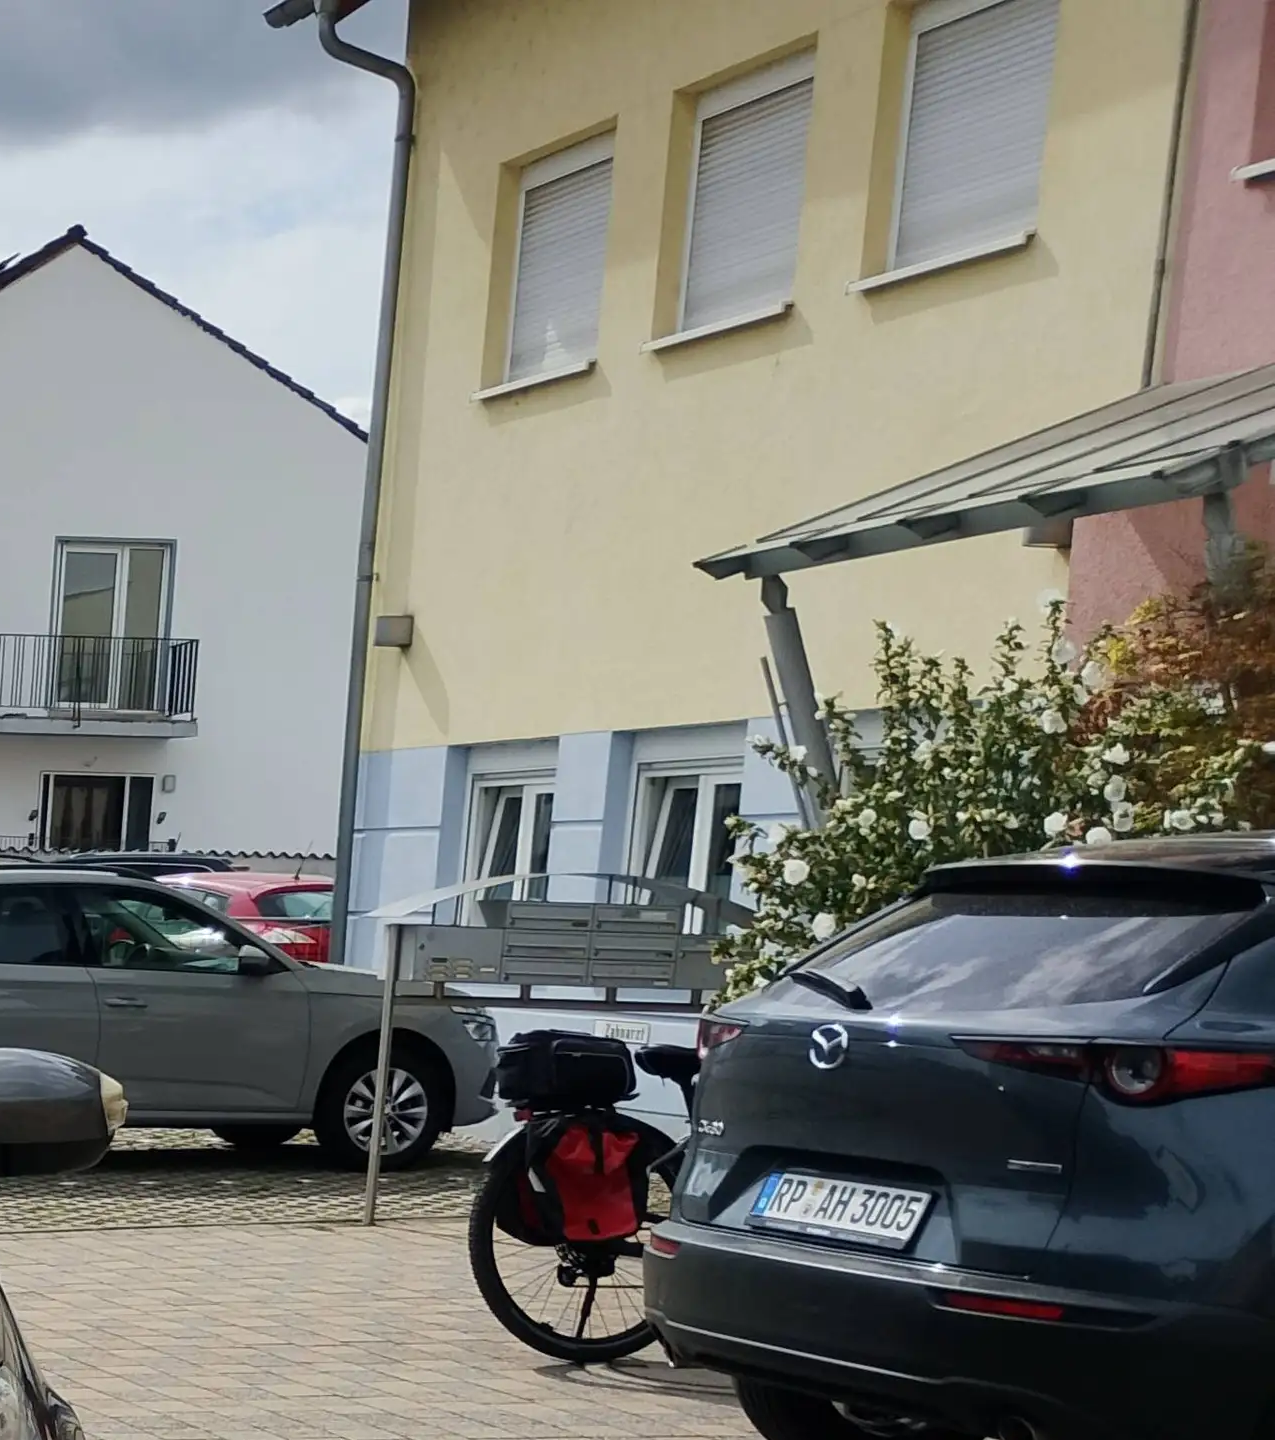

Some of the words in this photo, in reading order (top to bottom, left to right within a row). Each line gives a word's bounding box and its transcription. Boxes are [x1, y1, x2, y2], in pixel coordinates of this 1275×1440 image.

[769, 1178, 808, 1213] RP
[813, 1184, 857, 1222] AH
[850, 1189, 923, 1232] 3005
